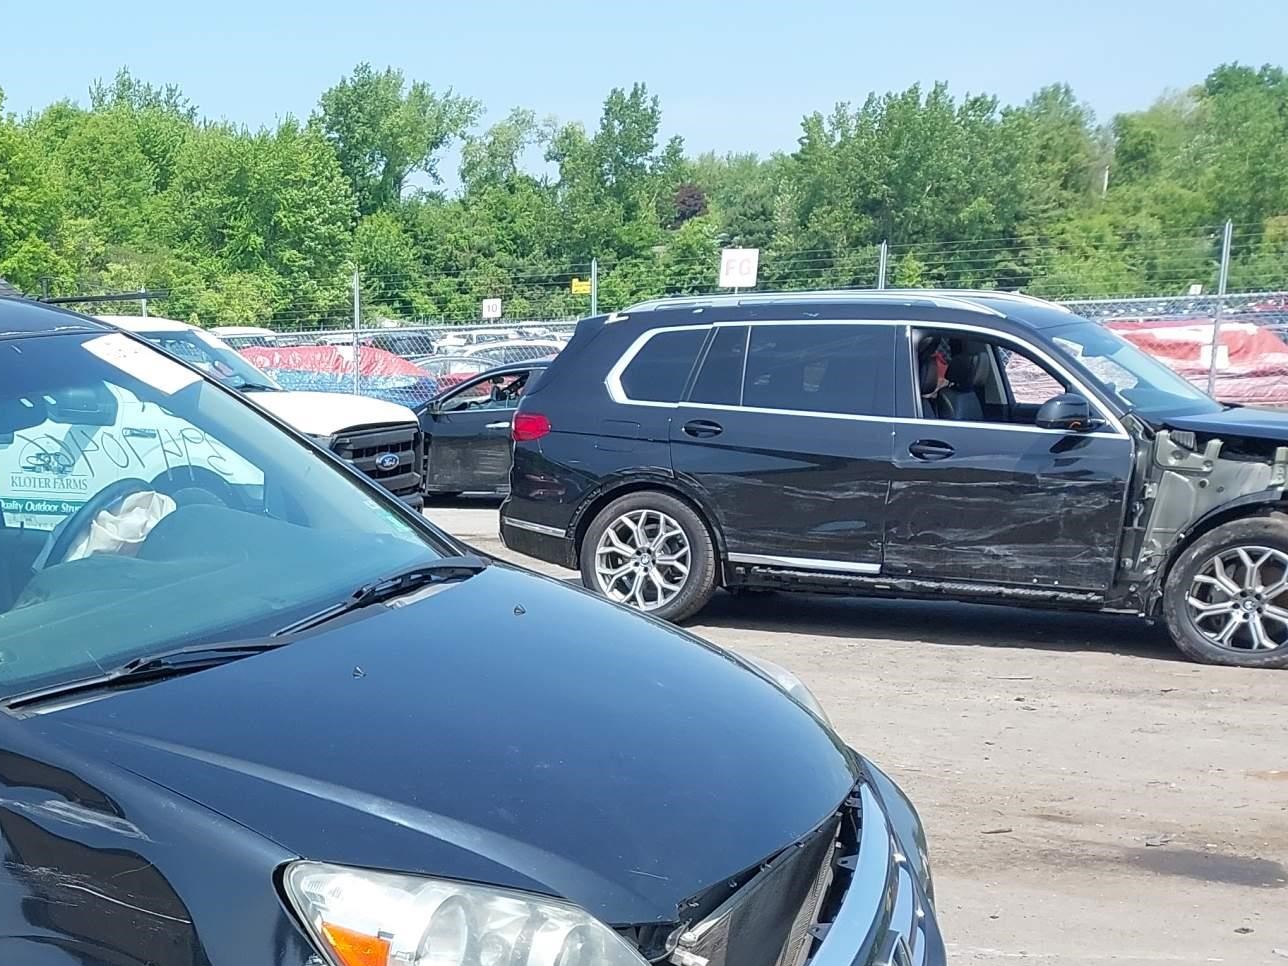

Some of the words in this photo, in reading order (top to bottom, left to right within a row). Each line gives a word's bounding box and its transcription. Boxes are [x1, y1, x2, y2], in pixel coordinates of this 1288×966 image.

[487, 304, 498, 313] 10
[11, 475, 51, 489] KLOTER
[53, 478, 88, 491] FARMS
[24, 501, 59, 513] Outdoor
